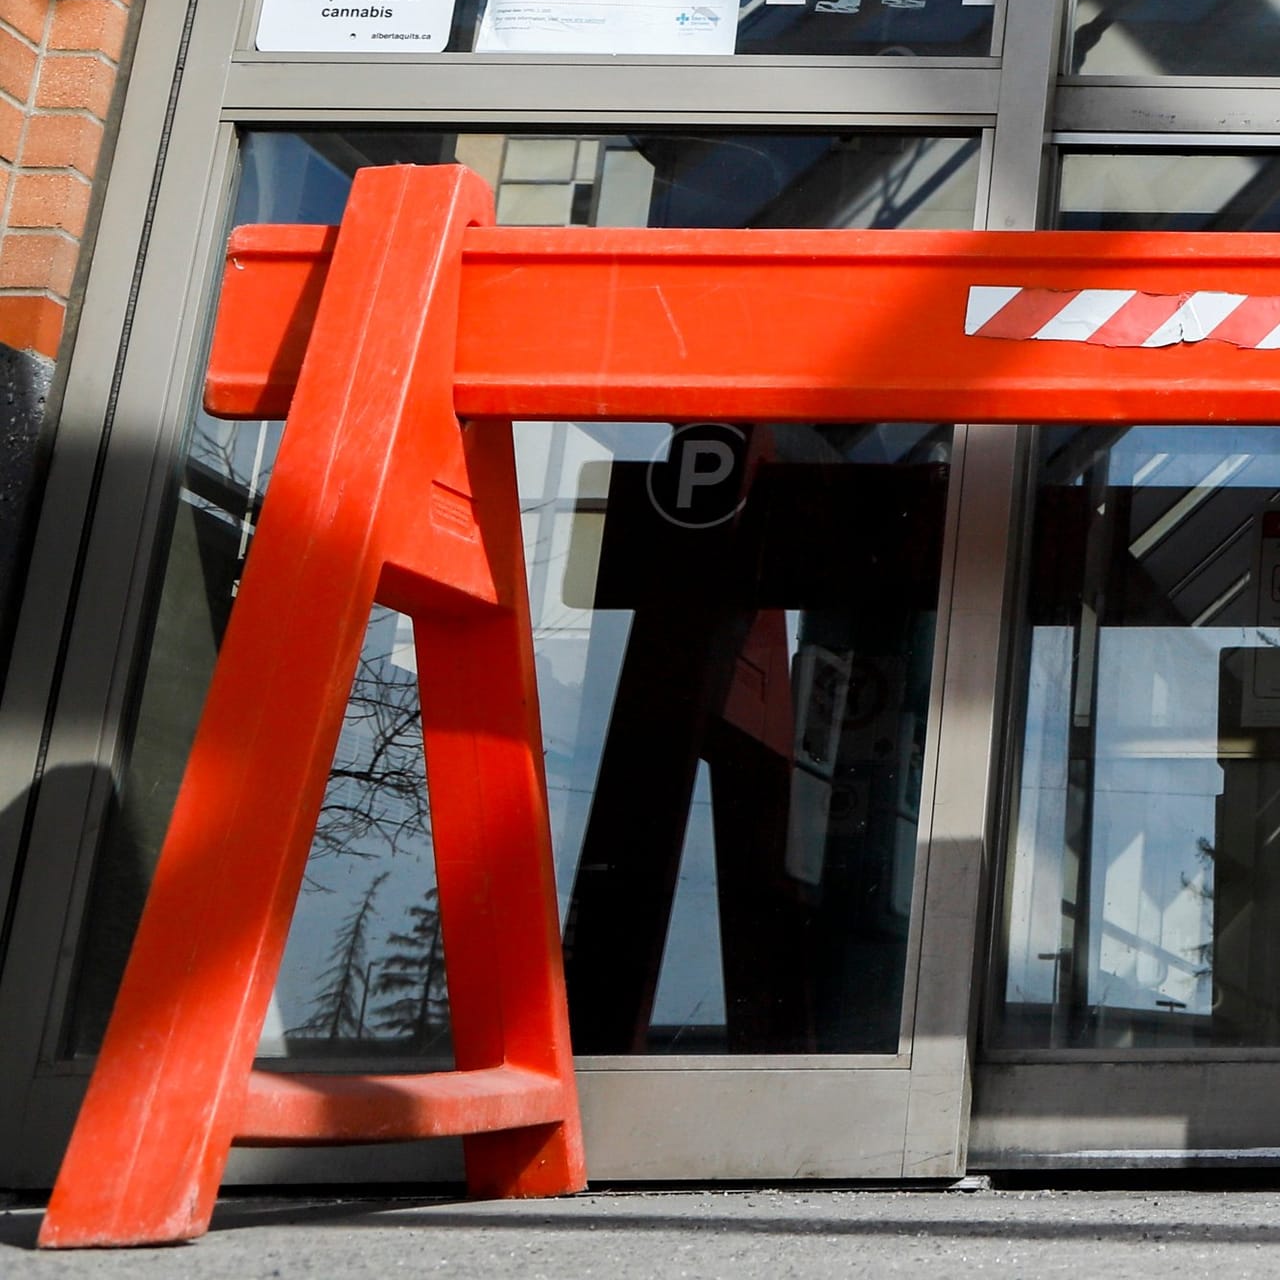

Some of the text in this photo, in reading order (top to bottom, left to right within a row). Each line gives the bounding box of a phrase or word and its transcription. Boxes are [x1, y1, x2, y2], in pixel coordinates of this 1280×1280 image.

[321, 6, 393, 18] cannabis
[371, 32, 431, 40] albertaquits.ca
[676, 439, 735, 508] P
